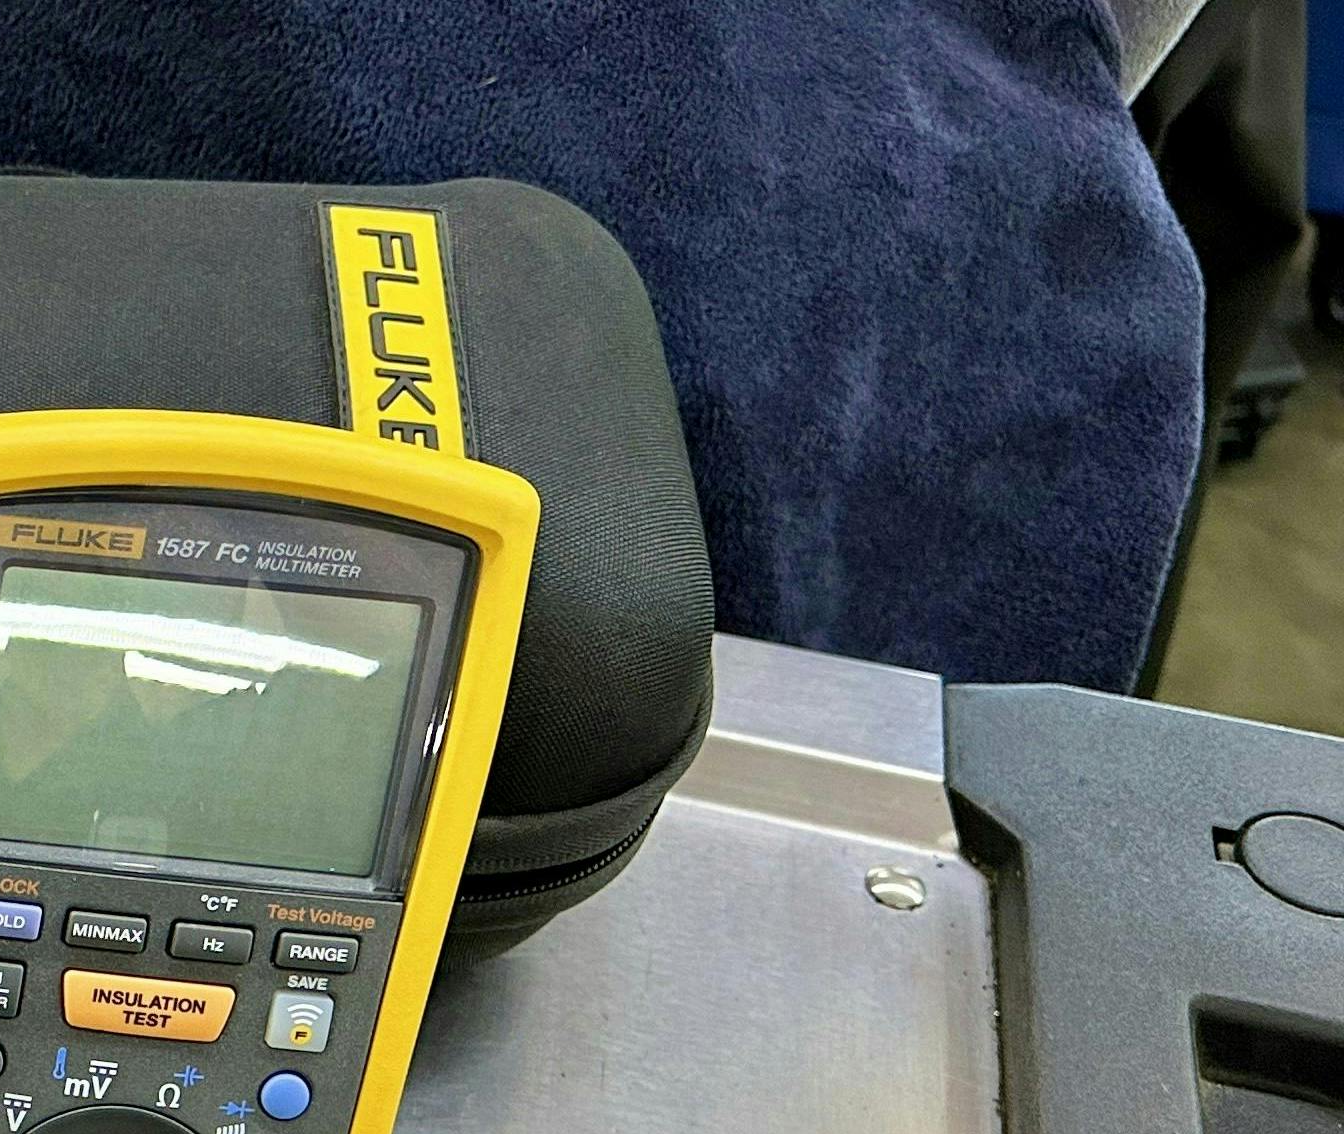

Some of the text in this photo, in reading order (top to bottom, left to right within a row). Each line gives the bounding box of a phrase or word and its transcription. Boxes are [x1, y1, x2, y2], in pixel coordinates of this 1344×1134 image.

[357, 227, 440, 451] FLUKE
[10, 522, 135, 553] FLUKE
[155, 535, 249, 566] 1587 FC
[257, 541, 358, 563] INSULATION
[254, 557, 363, 580] MULTIMETER
[267, 902, 376, 932] Test Voltage
[72, 922, 144, 944] MINMAX
[202, 936, 225, 953] Hz
[289, 944, 349, 964] RANGE
[287, 974, 329, 992] SAVE
[91, 987, 206, 1015] INSULATION
[122, 1010, 172, 1029] TEST
[64, 1076, 112, 1100] mV
